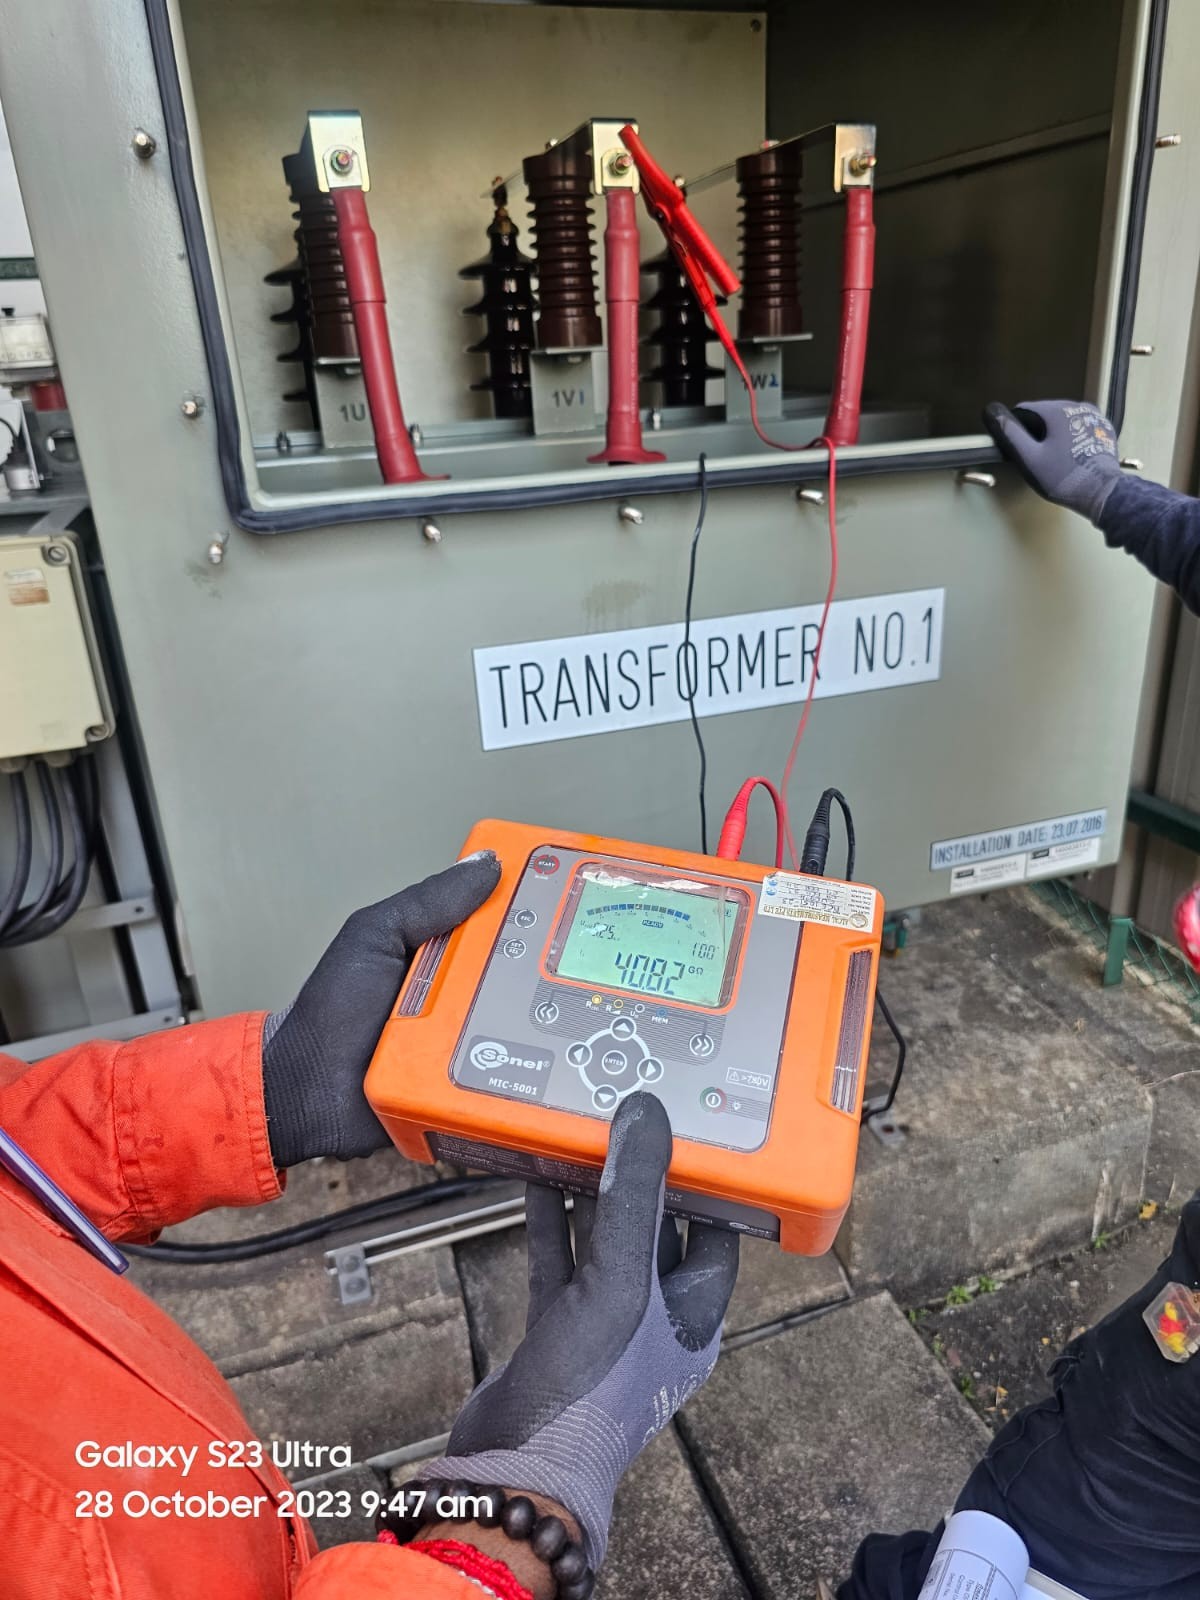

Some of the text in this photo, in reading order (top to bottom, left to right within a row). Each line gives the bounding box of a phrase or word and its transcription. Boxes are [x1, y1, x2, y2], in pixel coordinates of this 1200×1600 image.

[489, 606, 935, 729] TRANSFORMER NO.1
[934, 834, 1012, 865] INSTALLATION
[488, 1077, 538, 1096] MIC-5001
